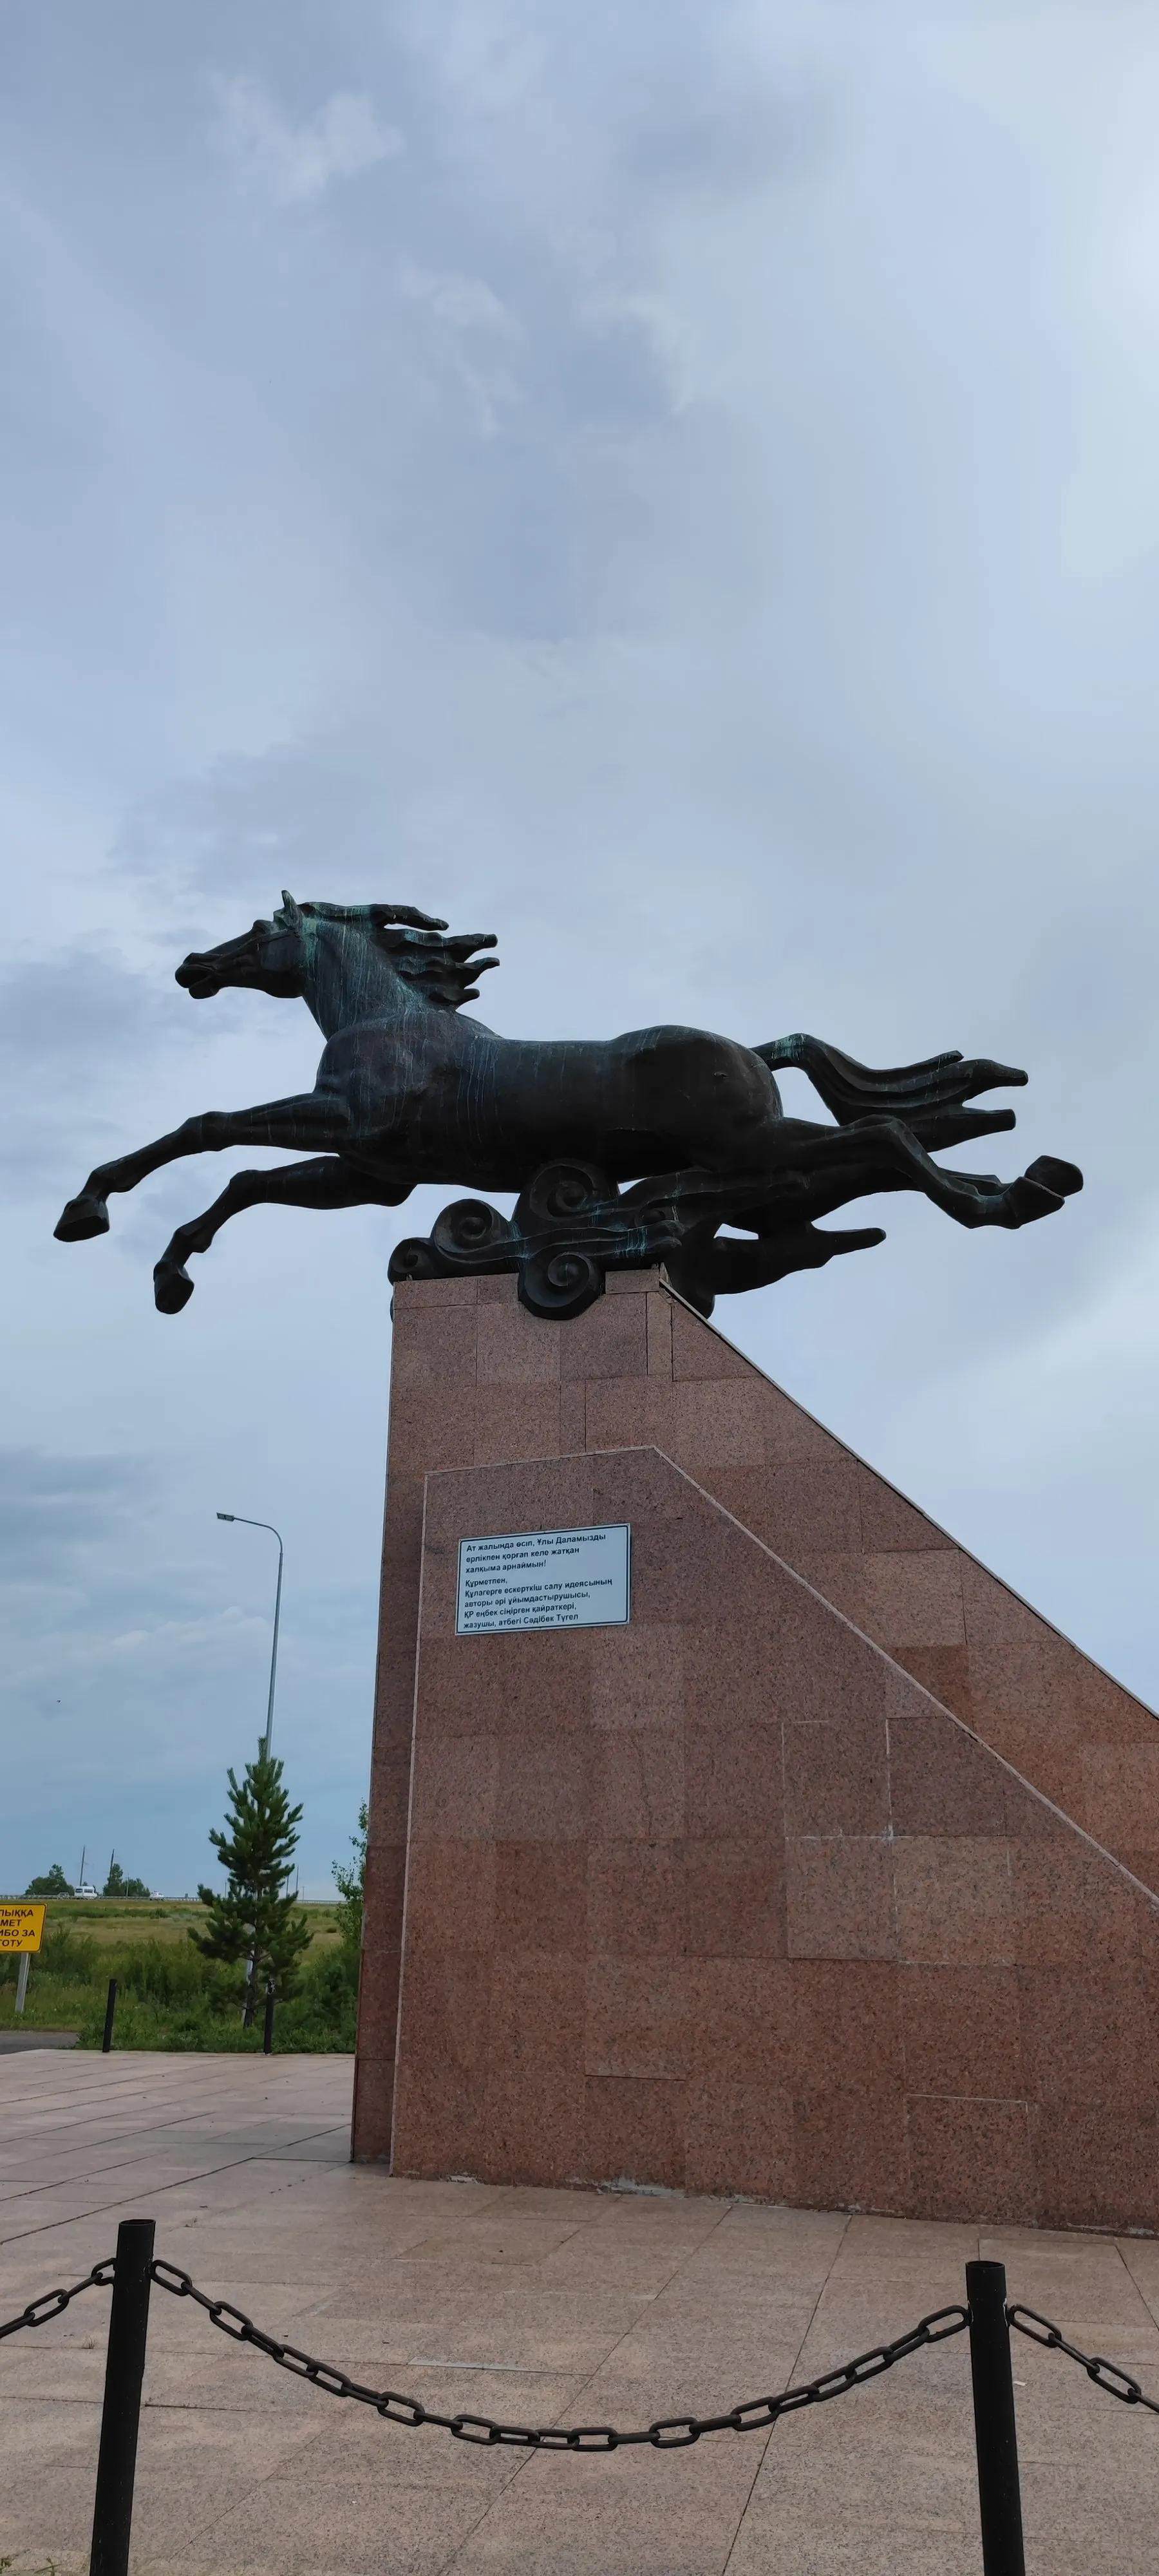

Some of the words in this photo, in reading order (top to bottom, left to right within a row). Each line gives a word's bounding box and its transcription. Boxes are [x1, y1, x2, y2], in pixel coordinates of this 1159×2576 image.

[478, 1542, 514, 1550] жалында
[556, 1534, 606, 1544] Даламызды
[466, 1554, 500, 1563] ерлікпен
[551, 1547, 580, 1556] жатқан
[466, 1565, 500, 1574] халқыма
[502, 1560, 546, 1570] арнаймын!
[504, 1584, 542, 1594] ескерткіш
[565, 1578, 612, 1589] идеясының
[464, 1599, 493, 1607] авторы
[476, 1607, 498, 1618] еңбек
[500, 1606, 530, 1616] сіңірген
[532, 1604, 577, 1613] қайраткері,
[464, 1620, 496, 1629] жазушы,
[498, 1618, 522, 1626] атбегі
[523, 1615, 554, 1625] Сәдібек
[556, 1613, 579, 1622] Түгел
